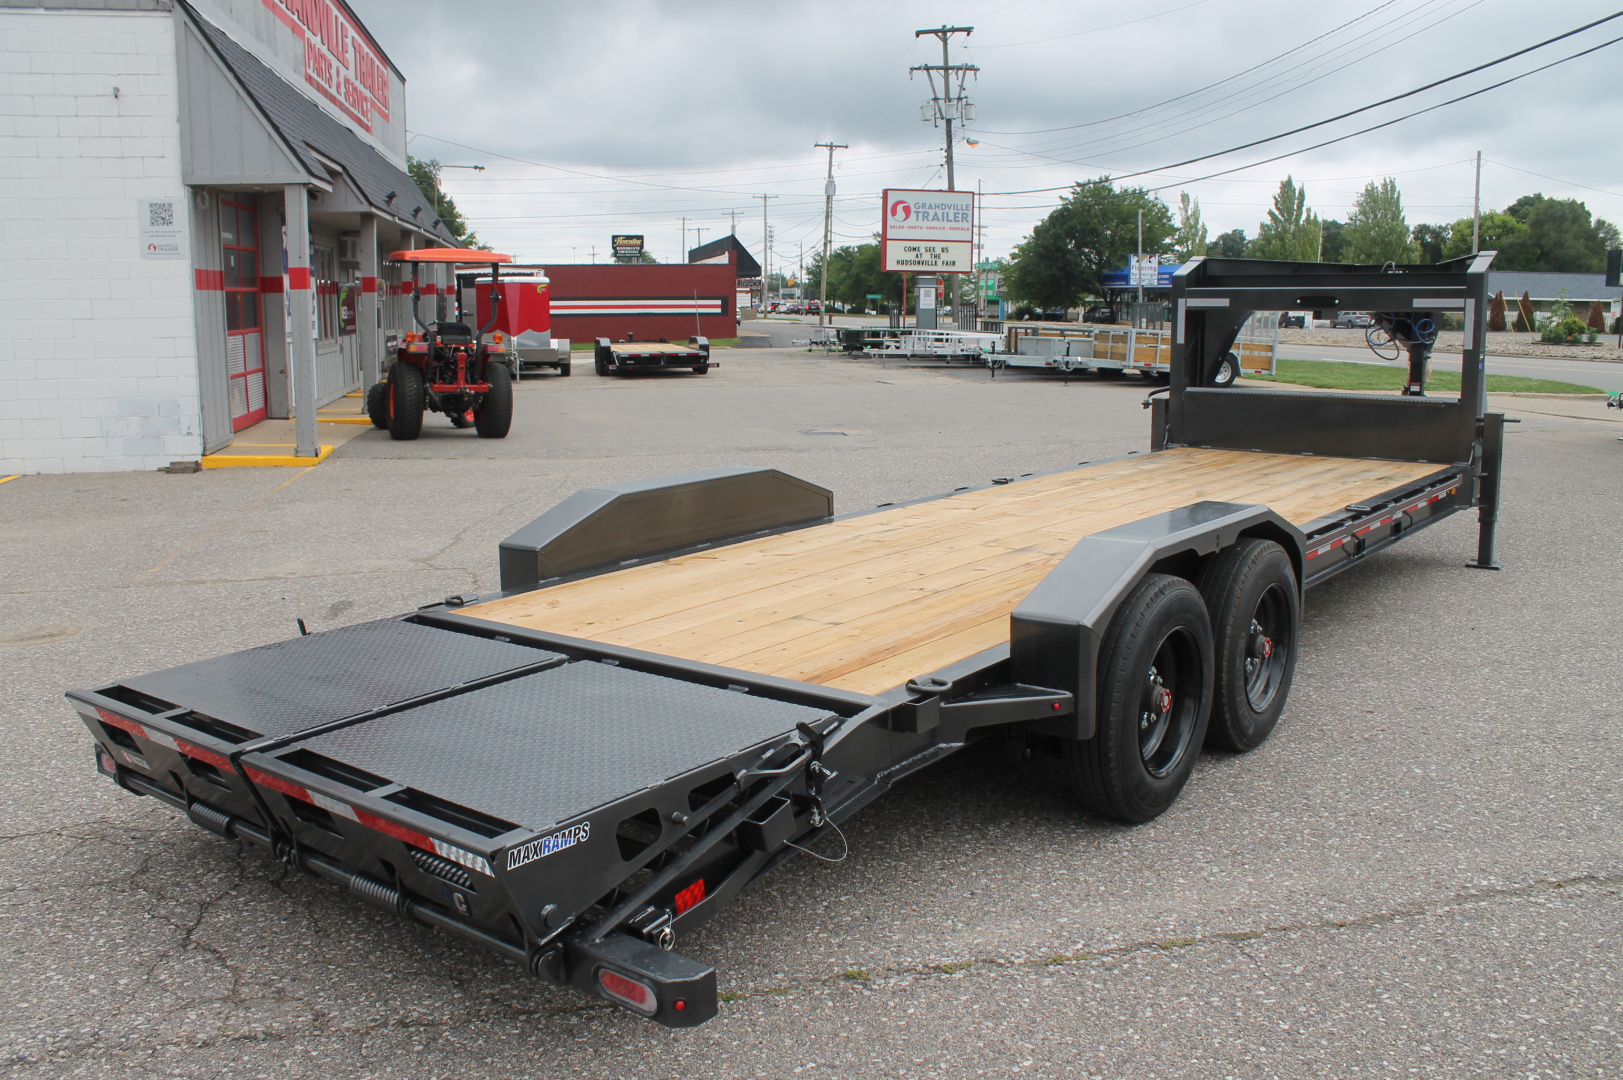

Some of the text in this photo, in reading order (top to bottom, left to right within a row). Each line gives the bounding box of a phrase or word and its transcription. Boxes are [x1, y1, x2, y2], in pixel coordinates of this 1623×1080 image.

[278, 0, 389, 111] NDVILLE TRAILER
[306, 36, 371, 122] PARTS & SERVICE
[913, 202, 970, 211] GRANDVILLE
[913, 210, 969, 223] TRAILER
[896, 259, 938, 267] HUDSONVILLE
